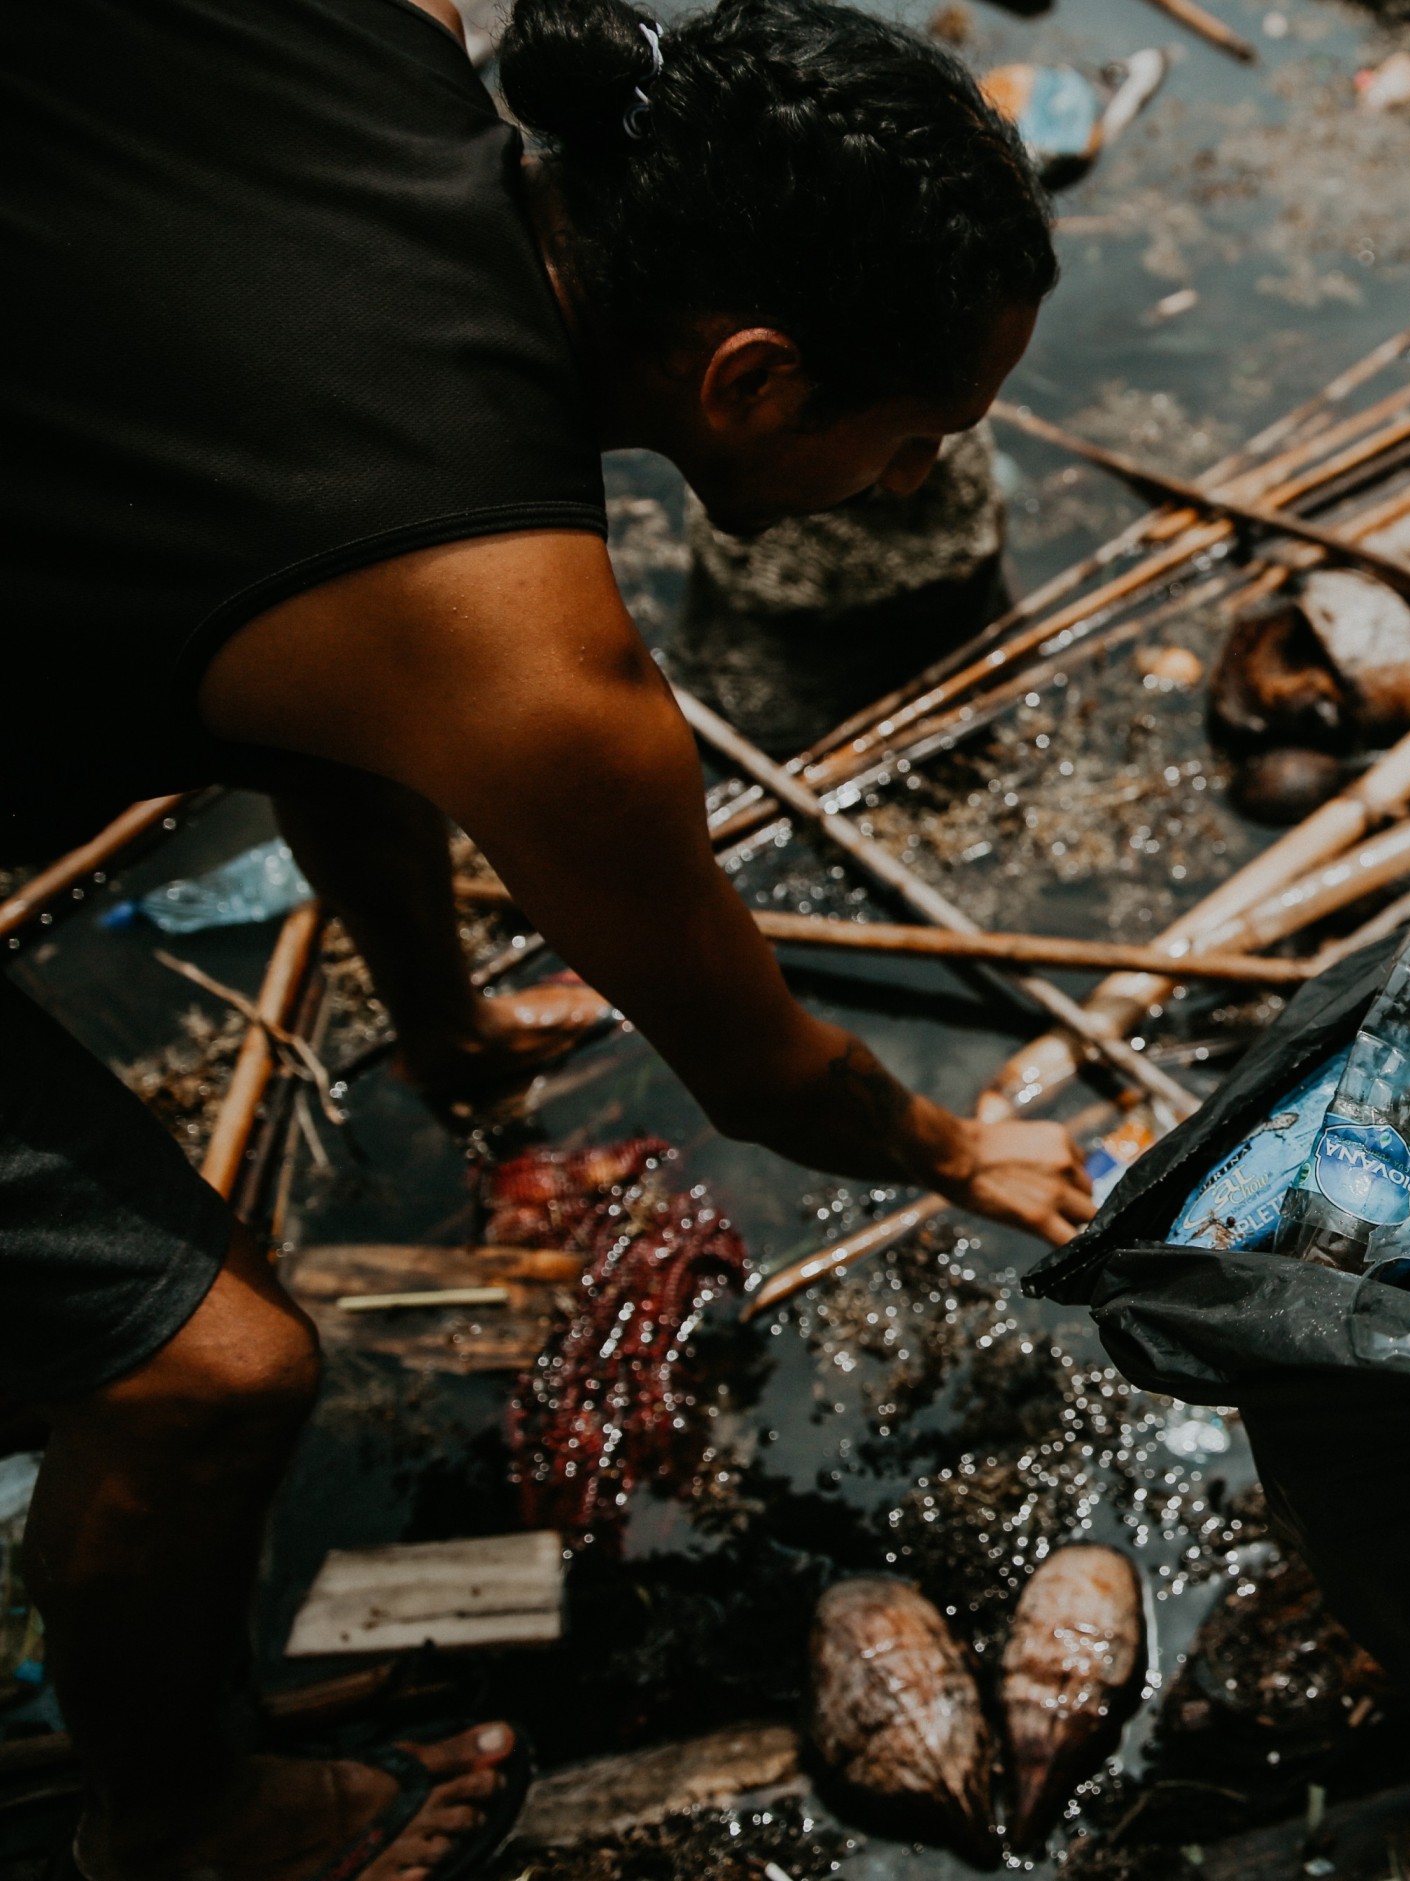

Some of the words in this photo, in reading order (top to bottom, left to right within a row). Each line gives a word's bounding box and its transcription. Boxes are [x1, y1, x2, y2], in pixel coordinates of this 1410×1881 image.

[1201, 1149, 1248, 1192] URINA
[1229, 1173, 1269, 1204] Chow
[1183, 1164, 1255, 1230] Cat
